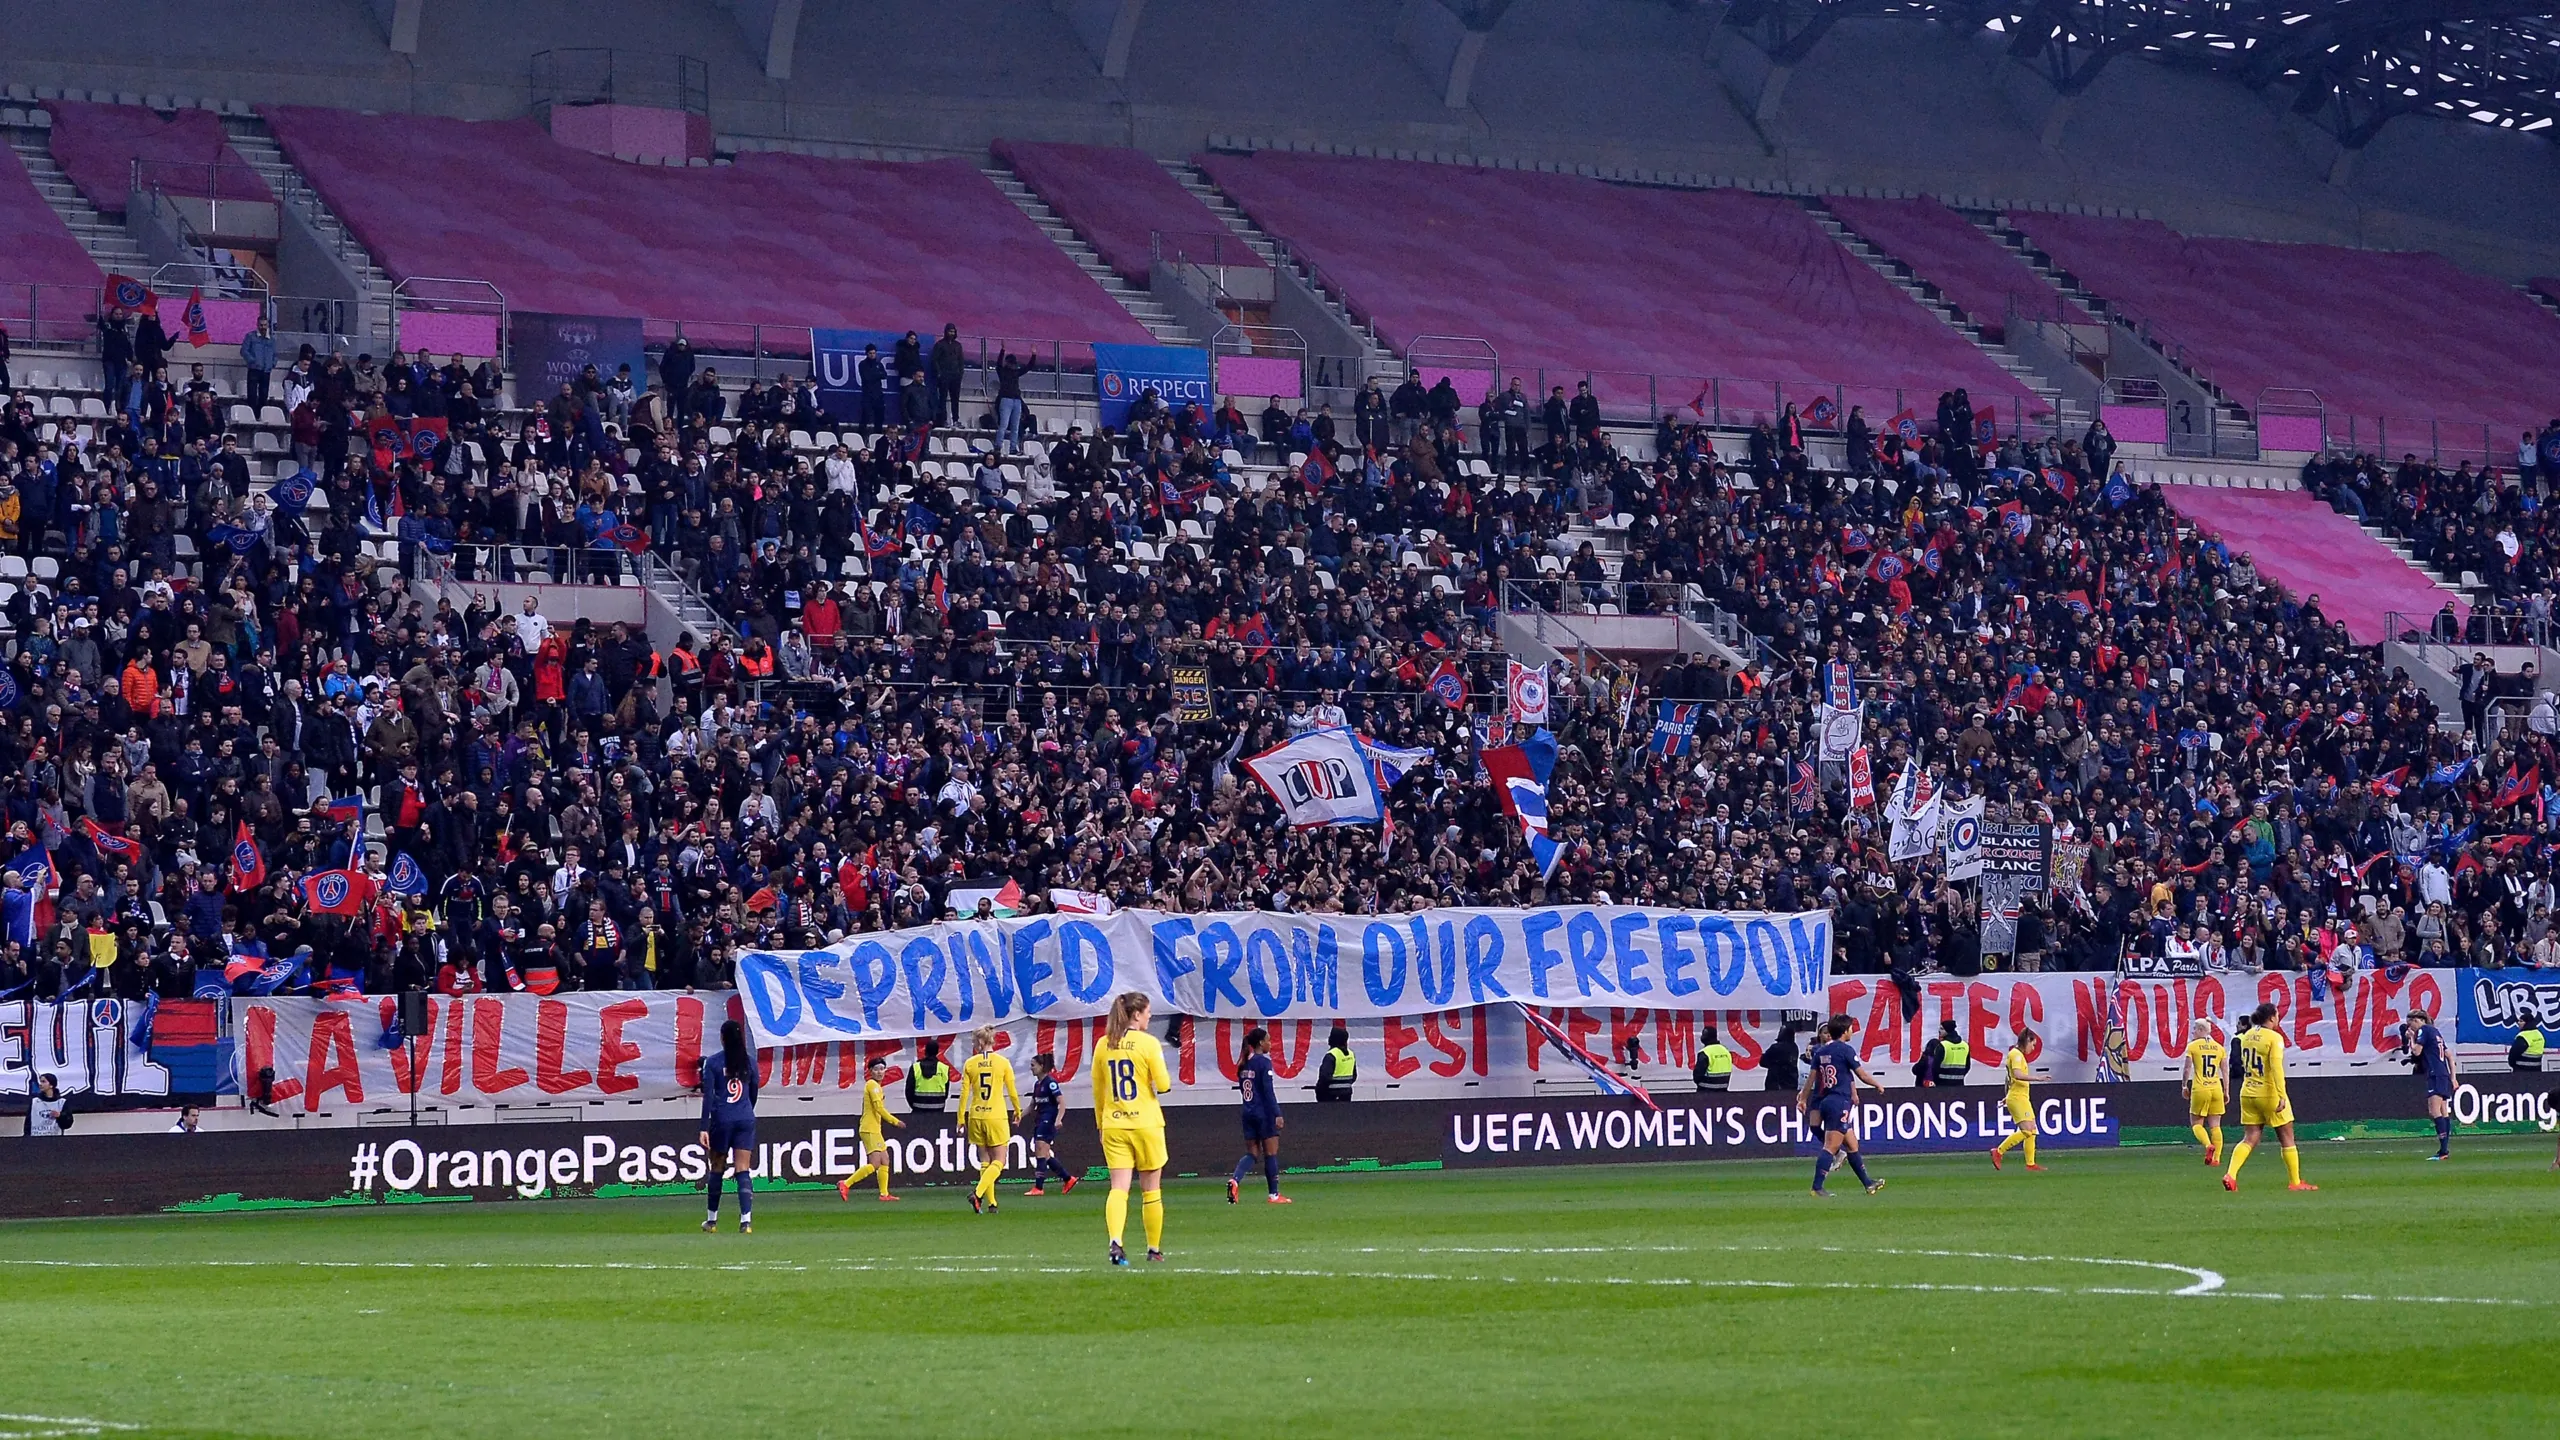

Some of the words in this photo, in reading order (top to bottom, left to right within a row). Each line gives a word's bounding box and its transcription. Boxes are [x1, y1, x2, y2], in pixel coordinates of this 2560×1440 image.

[1129, 376, 1207, 400] RESPECT
[1174, 676, 1205, 684] DANGER
[1655, 719, 1683, 735] PARIS
[1278, 758, 1358, 807] CUP
[1981, 836, 2040, 848] BLANC
[1982, 824, 2040, 836] BLEU
[1981, 847, 2042, 860] ROUGE
[1982, 859, 2042, 872] BLANC
[741, 918, 1114, 1036] DEPRIVED
[1151, 916, 1339, 1016] FROM
[1362, 914, 1511, 1005] OUR
[1522, 911, 1827, 998] FREEDOM
[2127, 957, 2170, 972] LPA
[2172, 960, 2198, 972] Paris
[245, 1004, 364, 1112] LA
[378, 996, 650, 1095] VILLE
[1828, 979, 2043, 1067] FAITES
[2072, 975, 2225, 1062] NOUS
[2202, 1055, 2217, 1077] 15
[2243, 1048, 2264, 1077] 24
[727, 1079, 743, 1103] 9
[980, 1073, 992, 1101] 5
[1108, 1059, 1138, 1102] 18
[1243, 1079, 1253, 1101] 8
[2447, 1083, 2557, 1131] Orang
[1454, 1112, 1559, 1153] UEFA
[1572, 1106, 1745, 1149] WOMEN'S
[1755, 1101, 1968, 1144] CHPIONS
[1979, 1097, 2108, 1138] LEGUE
